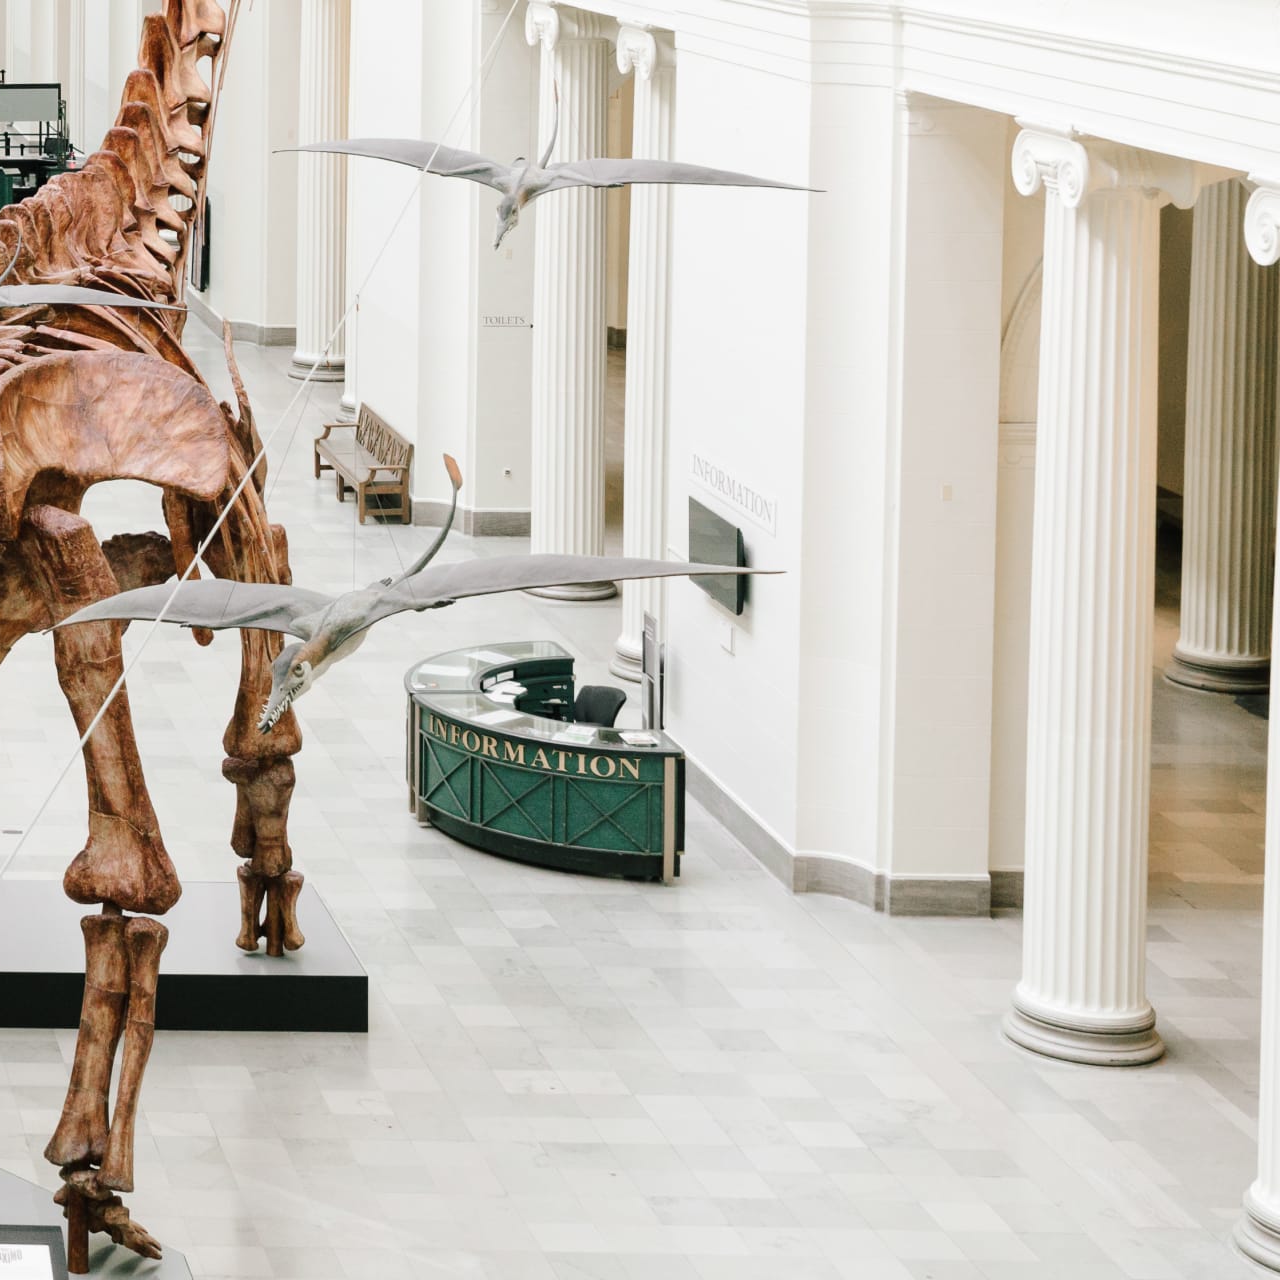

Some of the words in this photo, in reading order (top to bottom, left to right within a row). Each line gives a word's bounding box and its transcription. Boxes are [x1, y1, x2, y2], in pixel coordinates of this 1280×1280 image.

[483, 315, 526, 325] TOILETS
[692, 453, 773, 524] INFORMATION
[427, 714, 642, 780] INFORMATION
